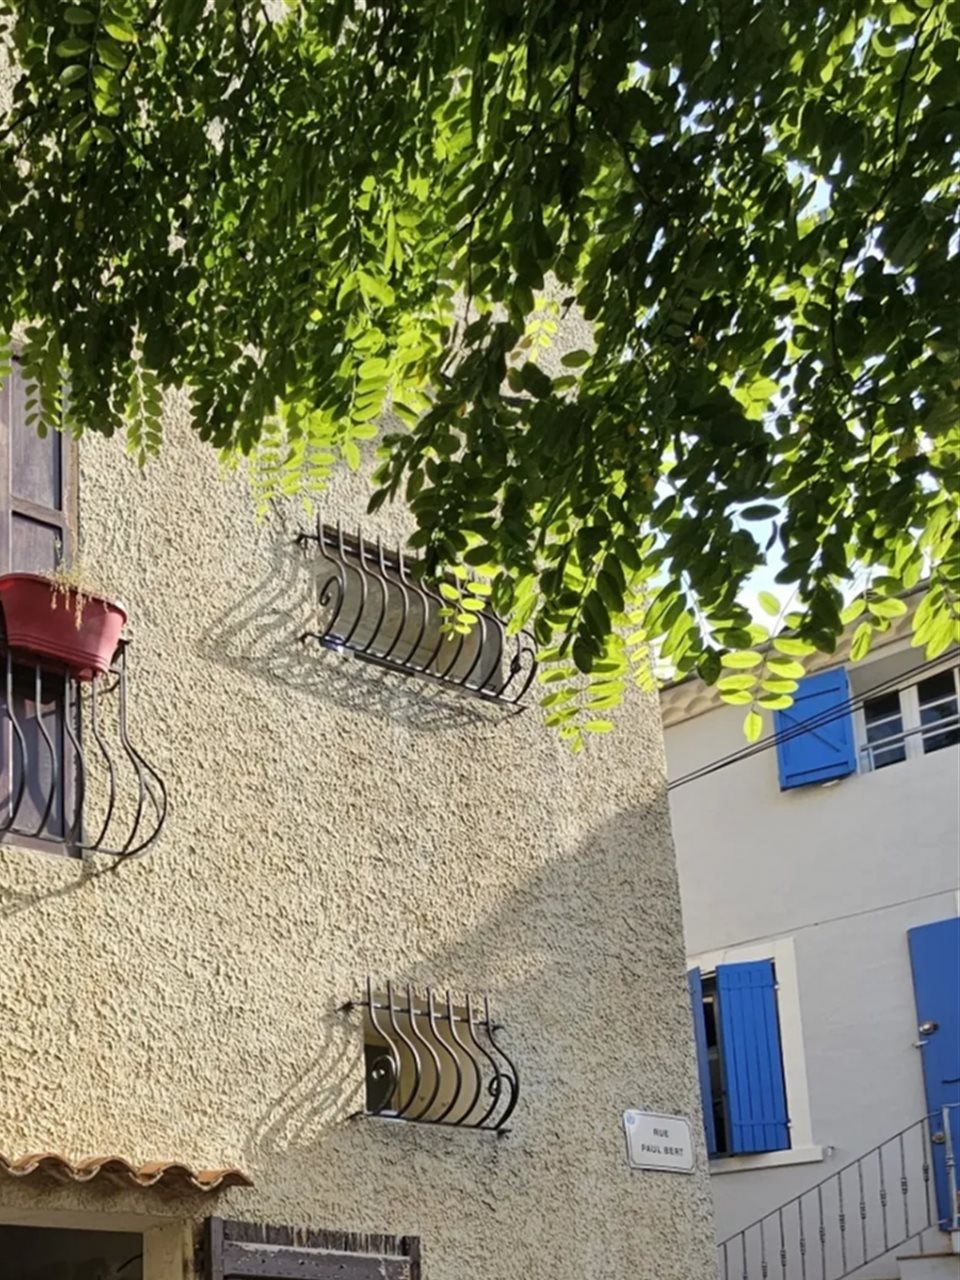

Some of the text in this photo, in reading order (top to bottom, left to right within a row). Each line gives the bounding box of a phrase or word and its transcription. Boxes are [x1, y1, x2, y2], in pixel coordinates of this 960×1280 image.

[652, 1128, 670, 1138] RUE
[641, 1144, 684, 1157] PAUL BERT
